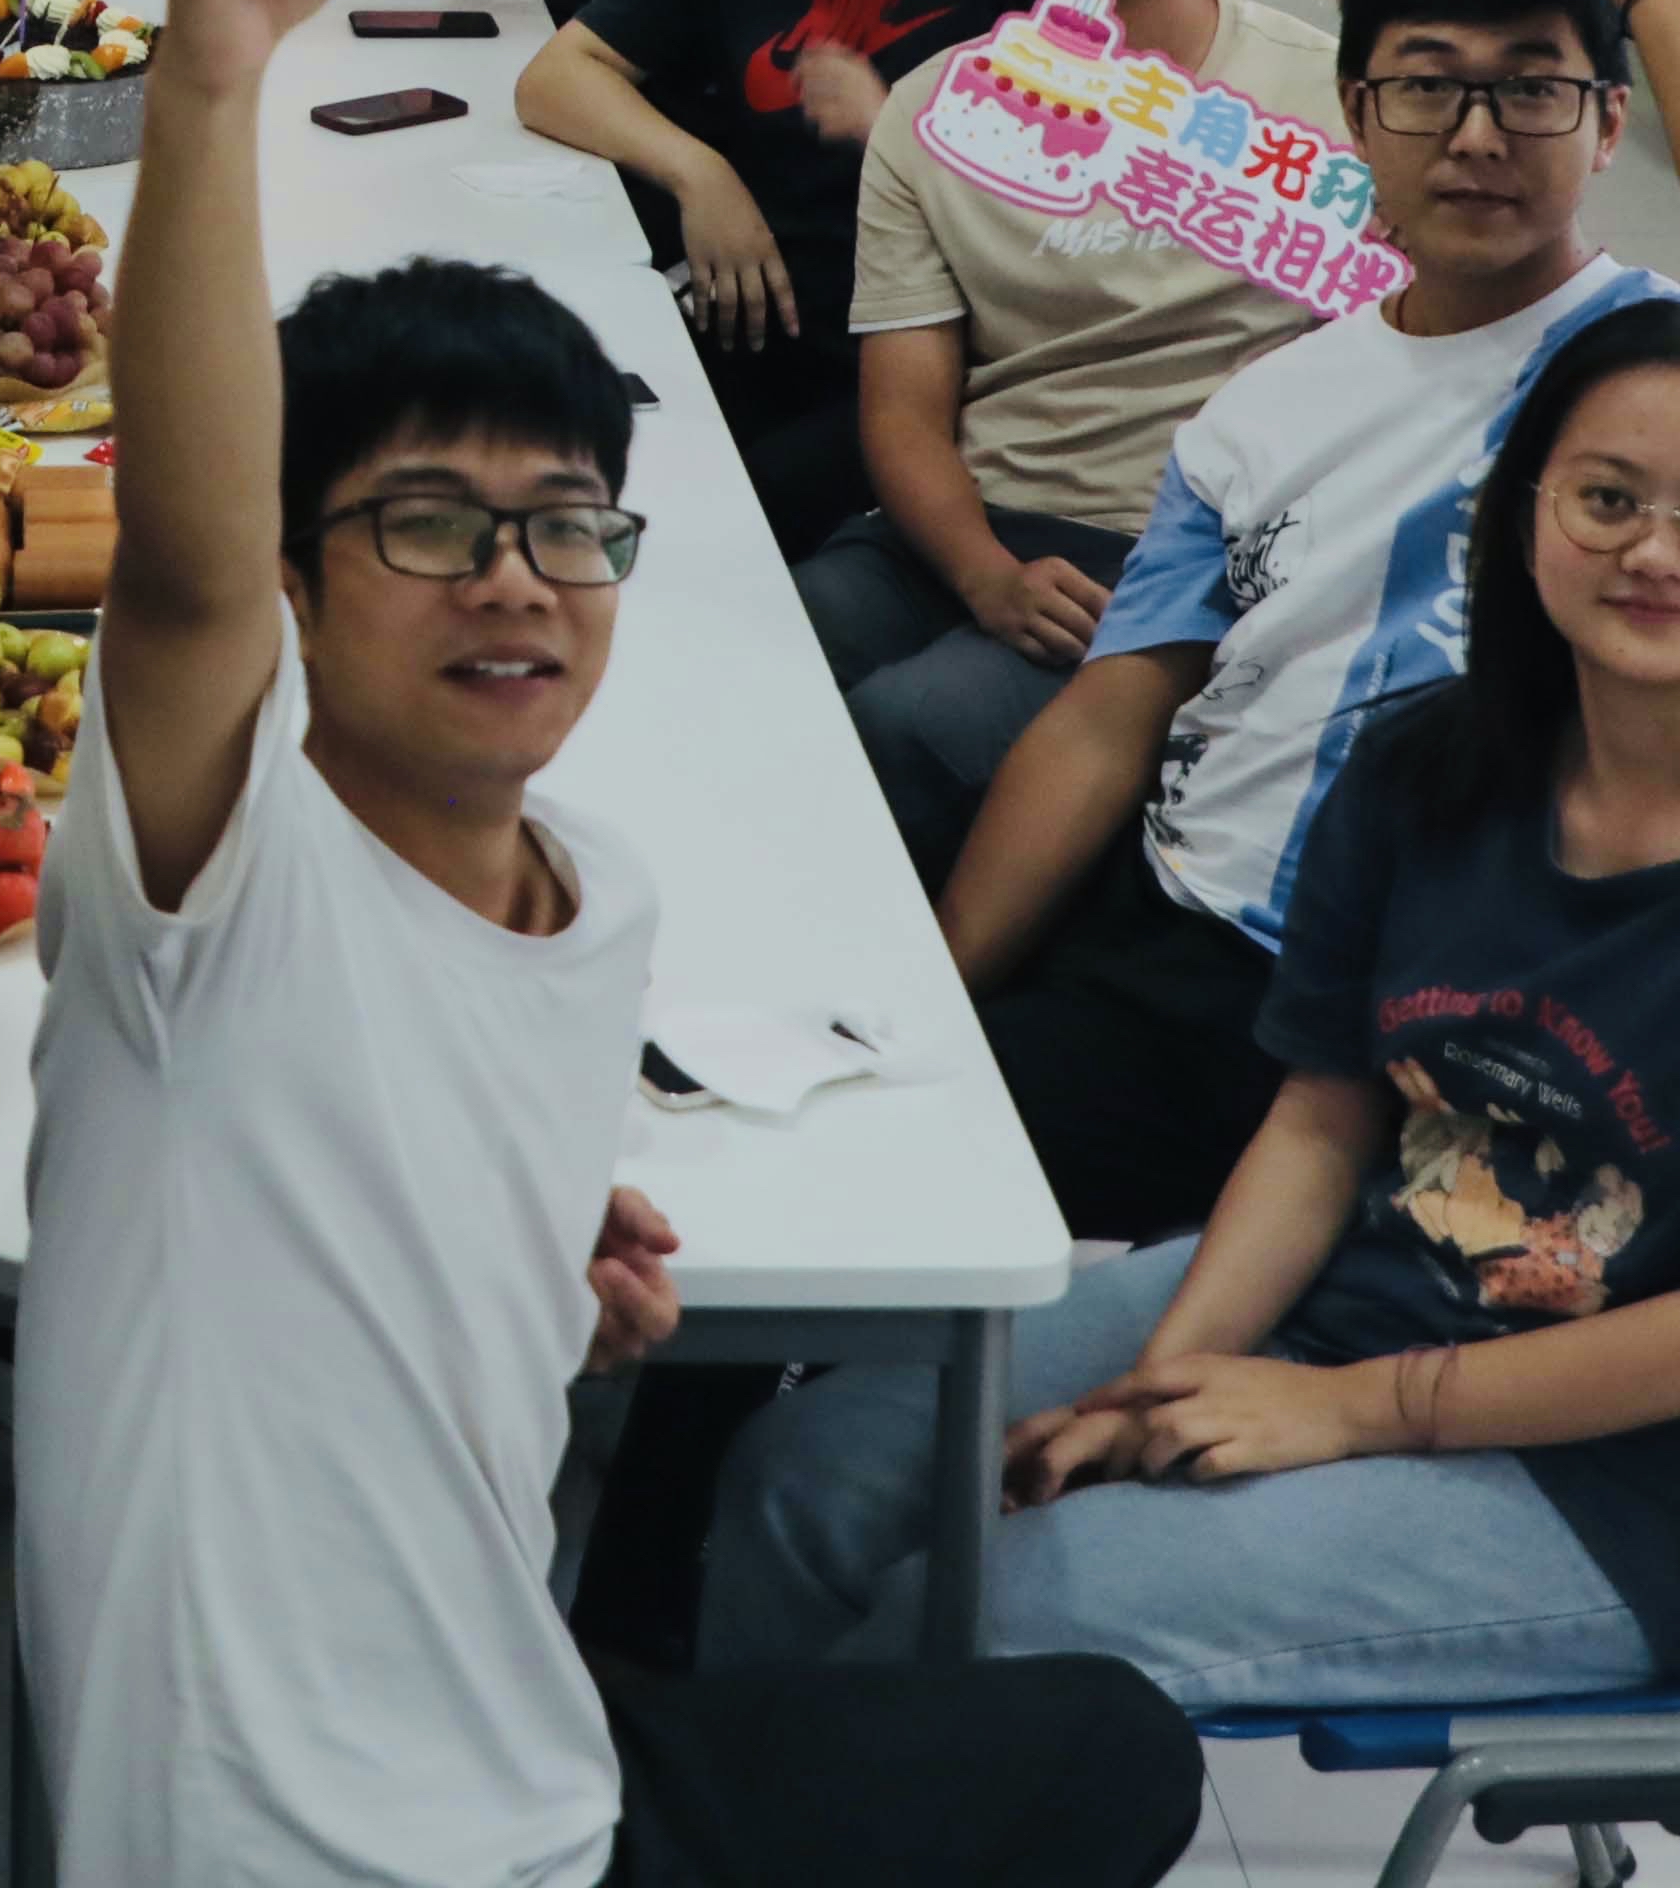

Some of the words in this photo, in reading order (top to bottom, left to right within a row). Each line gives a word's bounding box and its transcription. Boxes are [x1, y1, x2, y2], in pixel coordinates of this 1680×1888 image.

[1107, 63, 1375, 230] 主角光环
[1113, 145, 1396, 315] 幸运相伴
[1538, 1080, 1583, 1120] Wells
